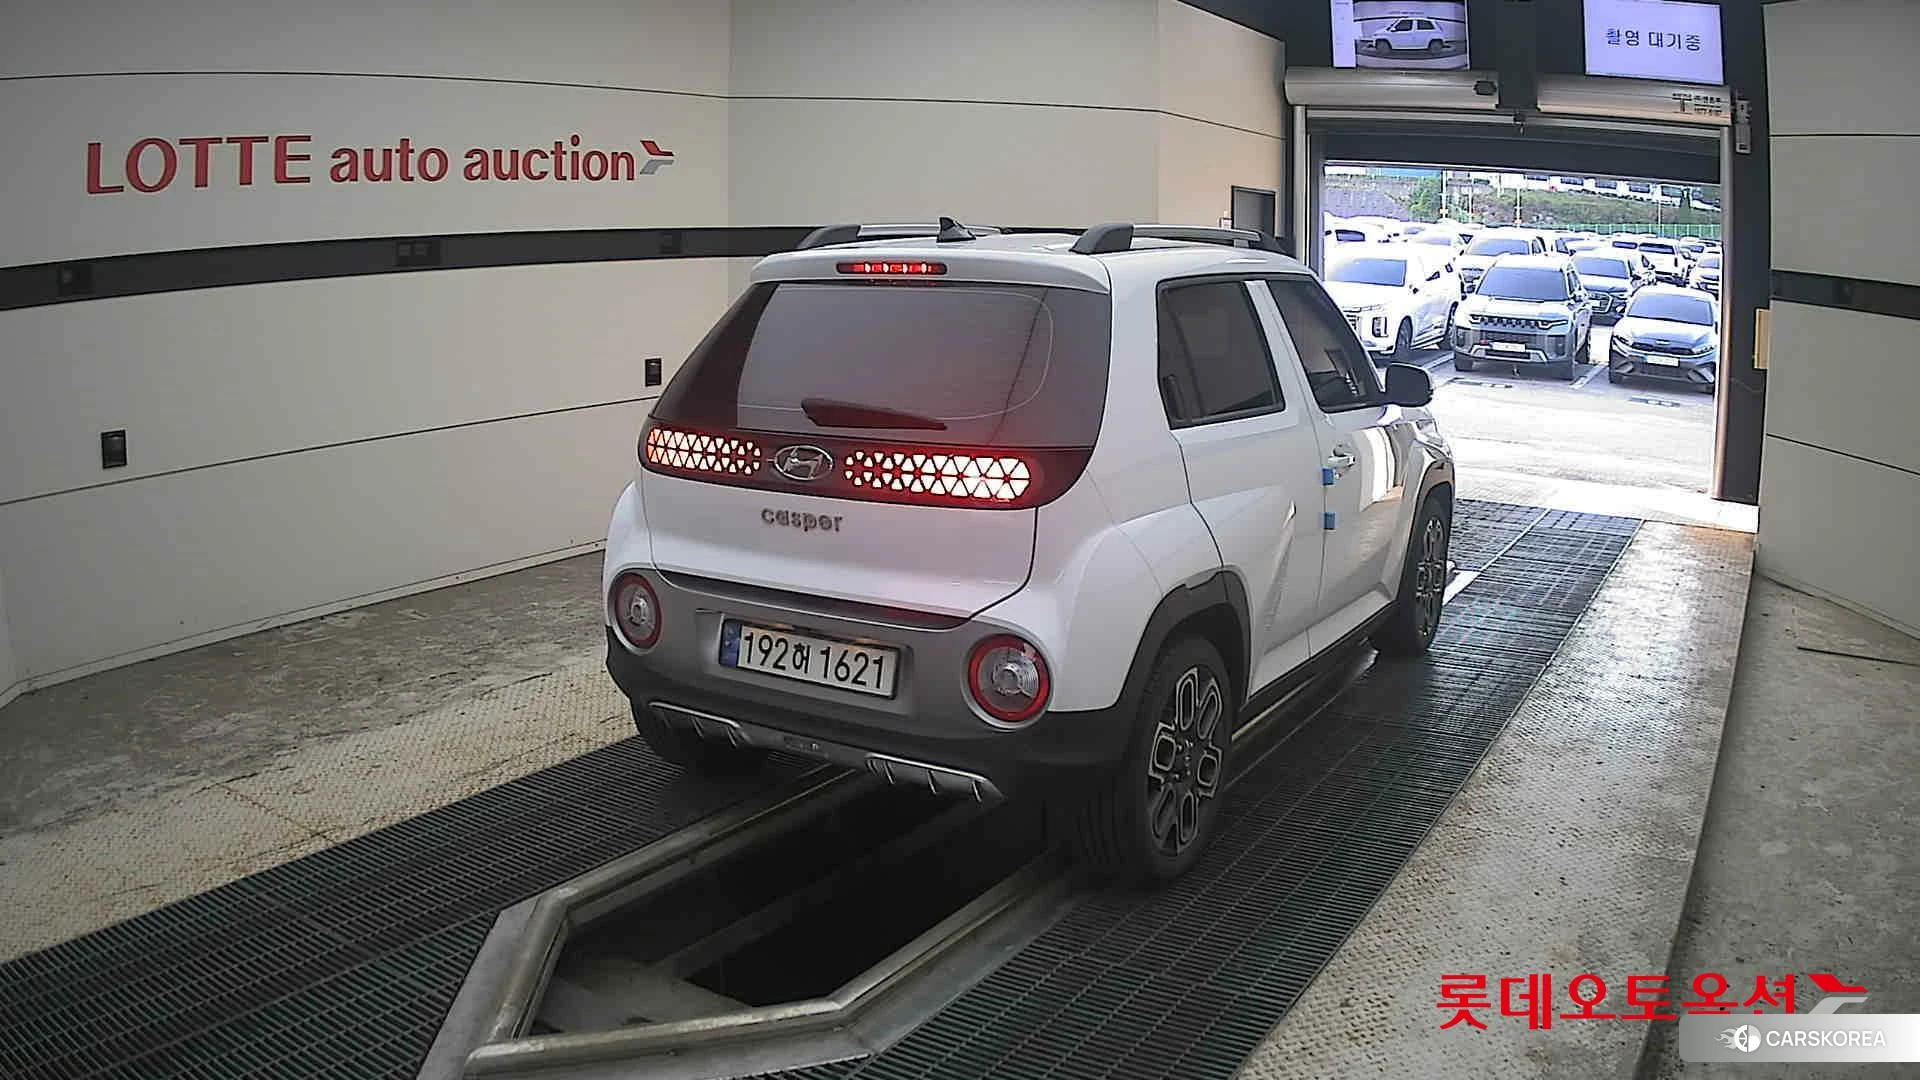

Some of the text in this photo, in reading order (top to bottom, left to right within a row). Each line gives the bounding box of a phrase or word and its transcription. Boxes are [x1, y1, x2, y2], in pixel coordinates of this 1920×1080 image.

[1648, 31, 1701, 52] 대기중
[85, 134, 636, 195] LOTTE auto auction
[761, 507, 843, 532] casper
[820, 645, 884, 690] 1621
